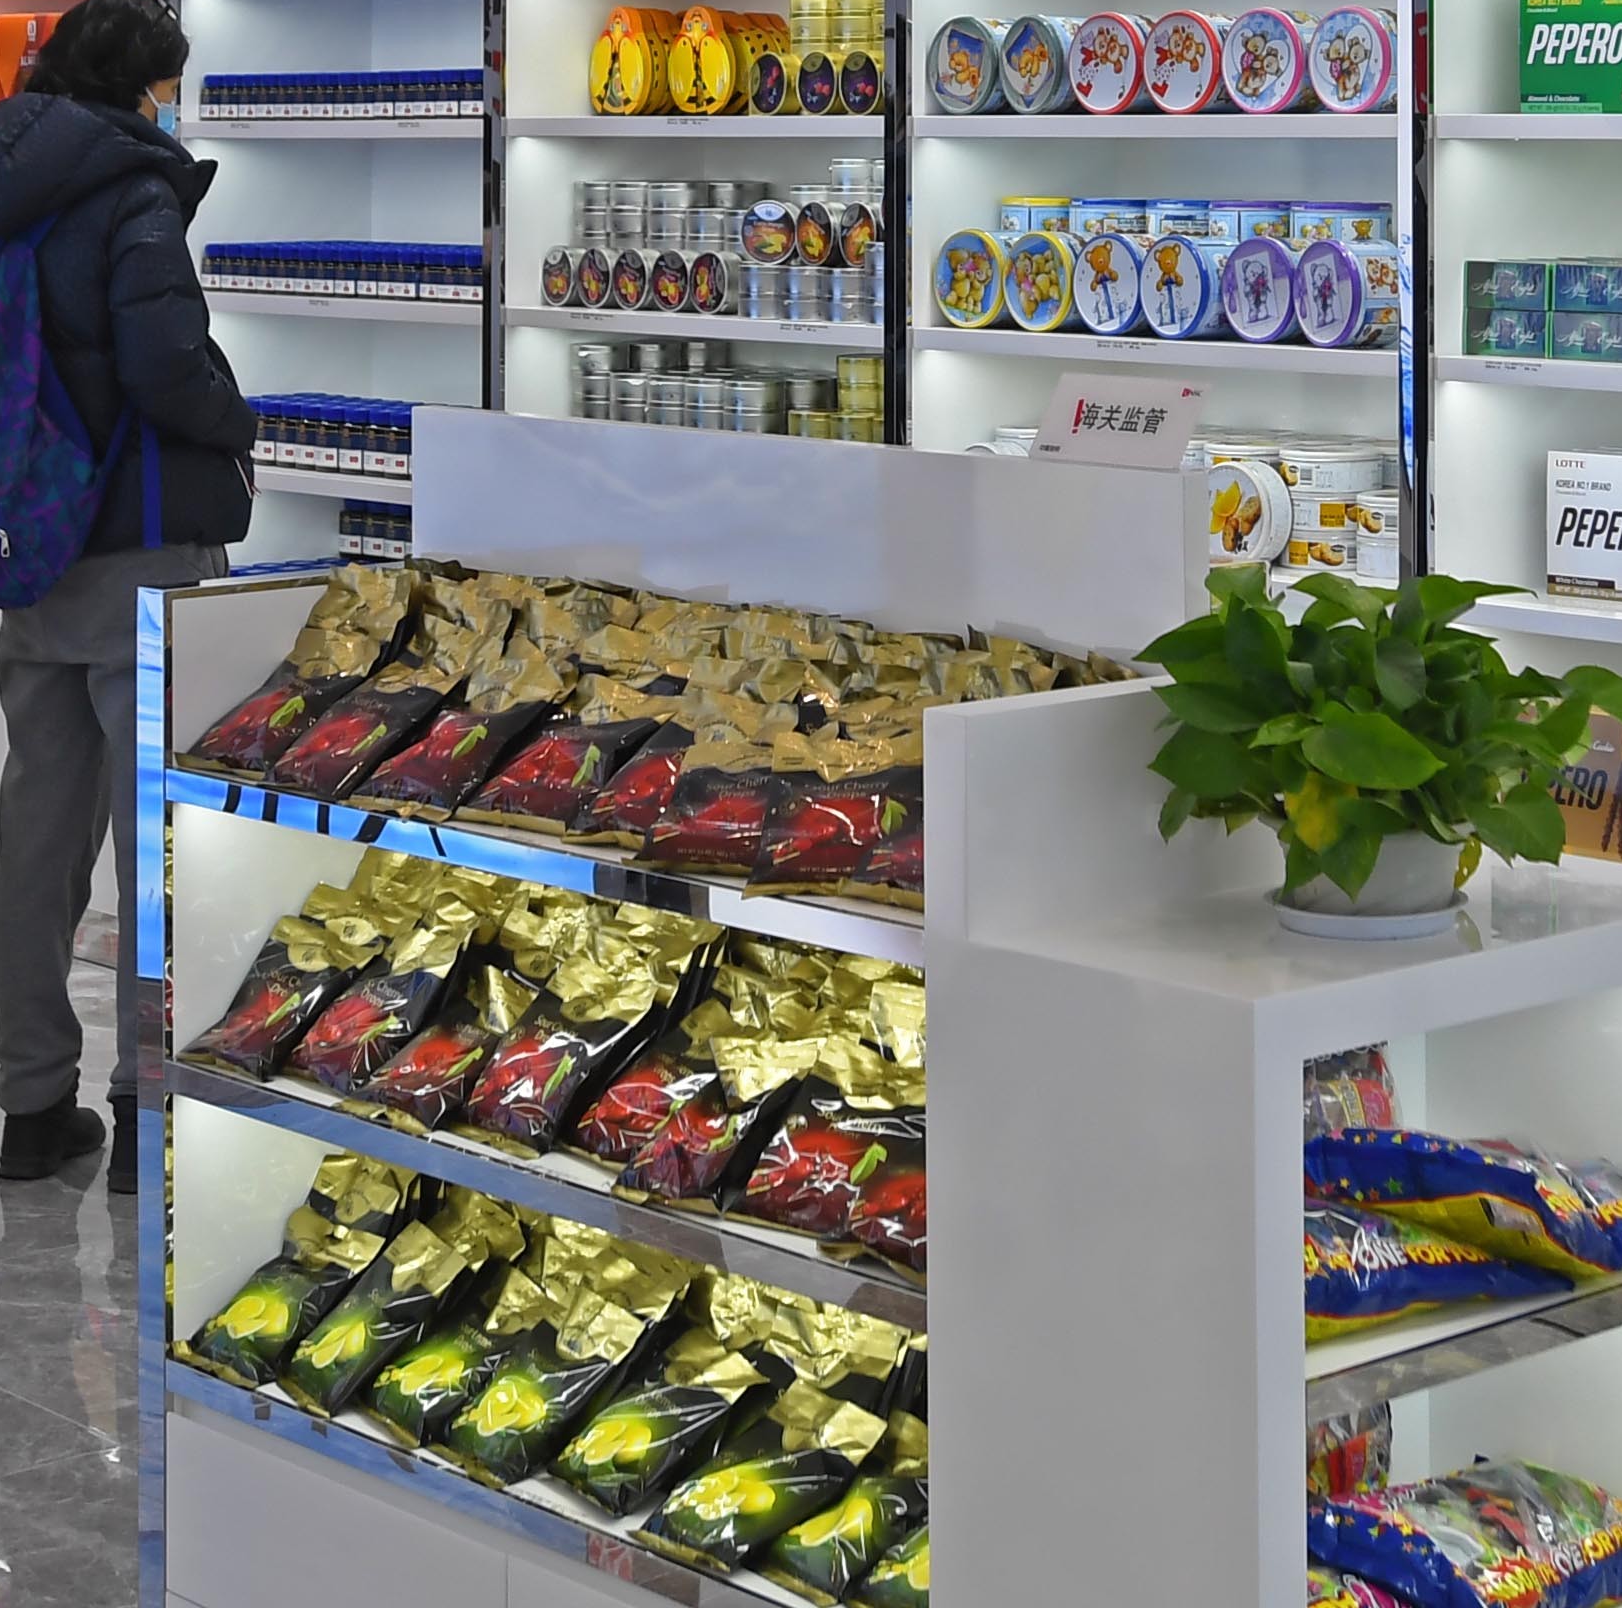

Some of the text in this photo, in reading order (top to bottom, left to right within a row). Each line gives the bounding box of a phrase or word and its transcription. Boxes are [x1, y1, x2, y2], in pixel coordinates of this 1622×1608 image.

[1080, 403, 1168, 435] 海关监管
[1555, 459, 1587, 469] LOTTE
[844, 781, 889, 793] Cherry
[1406, 1246, 1447, 1264] FOR
[1583, 1528, 1615, 1565] FOR
